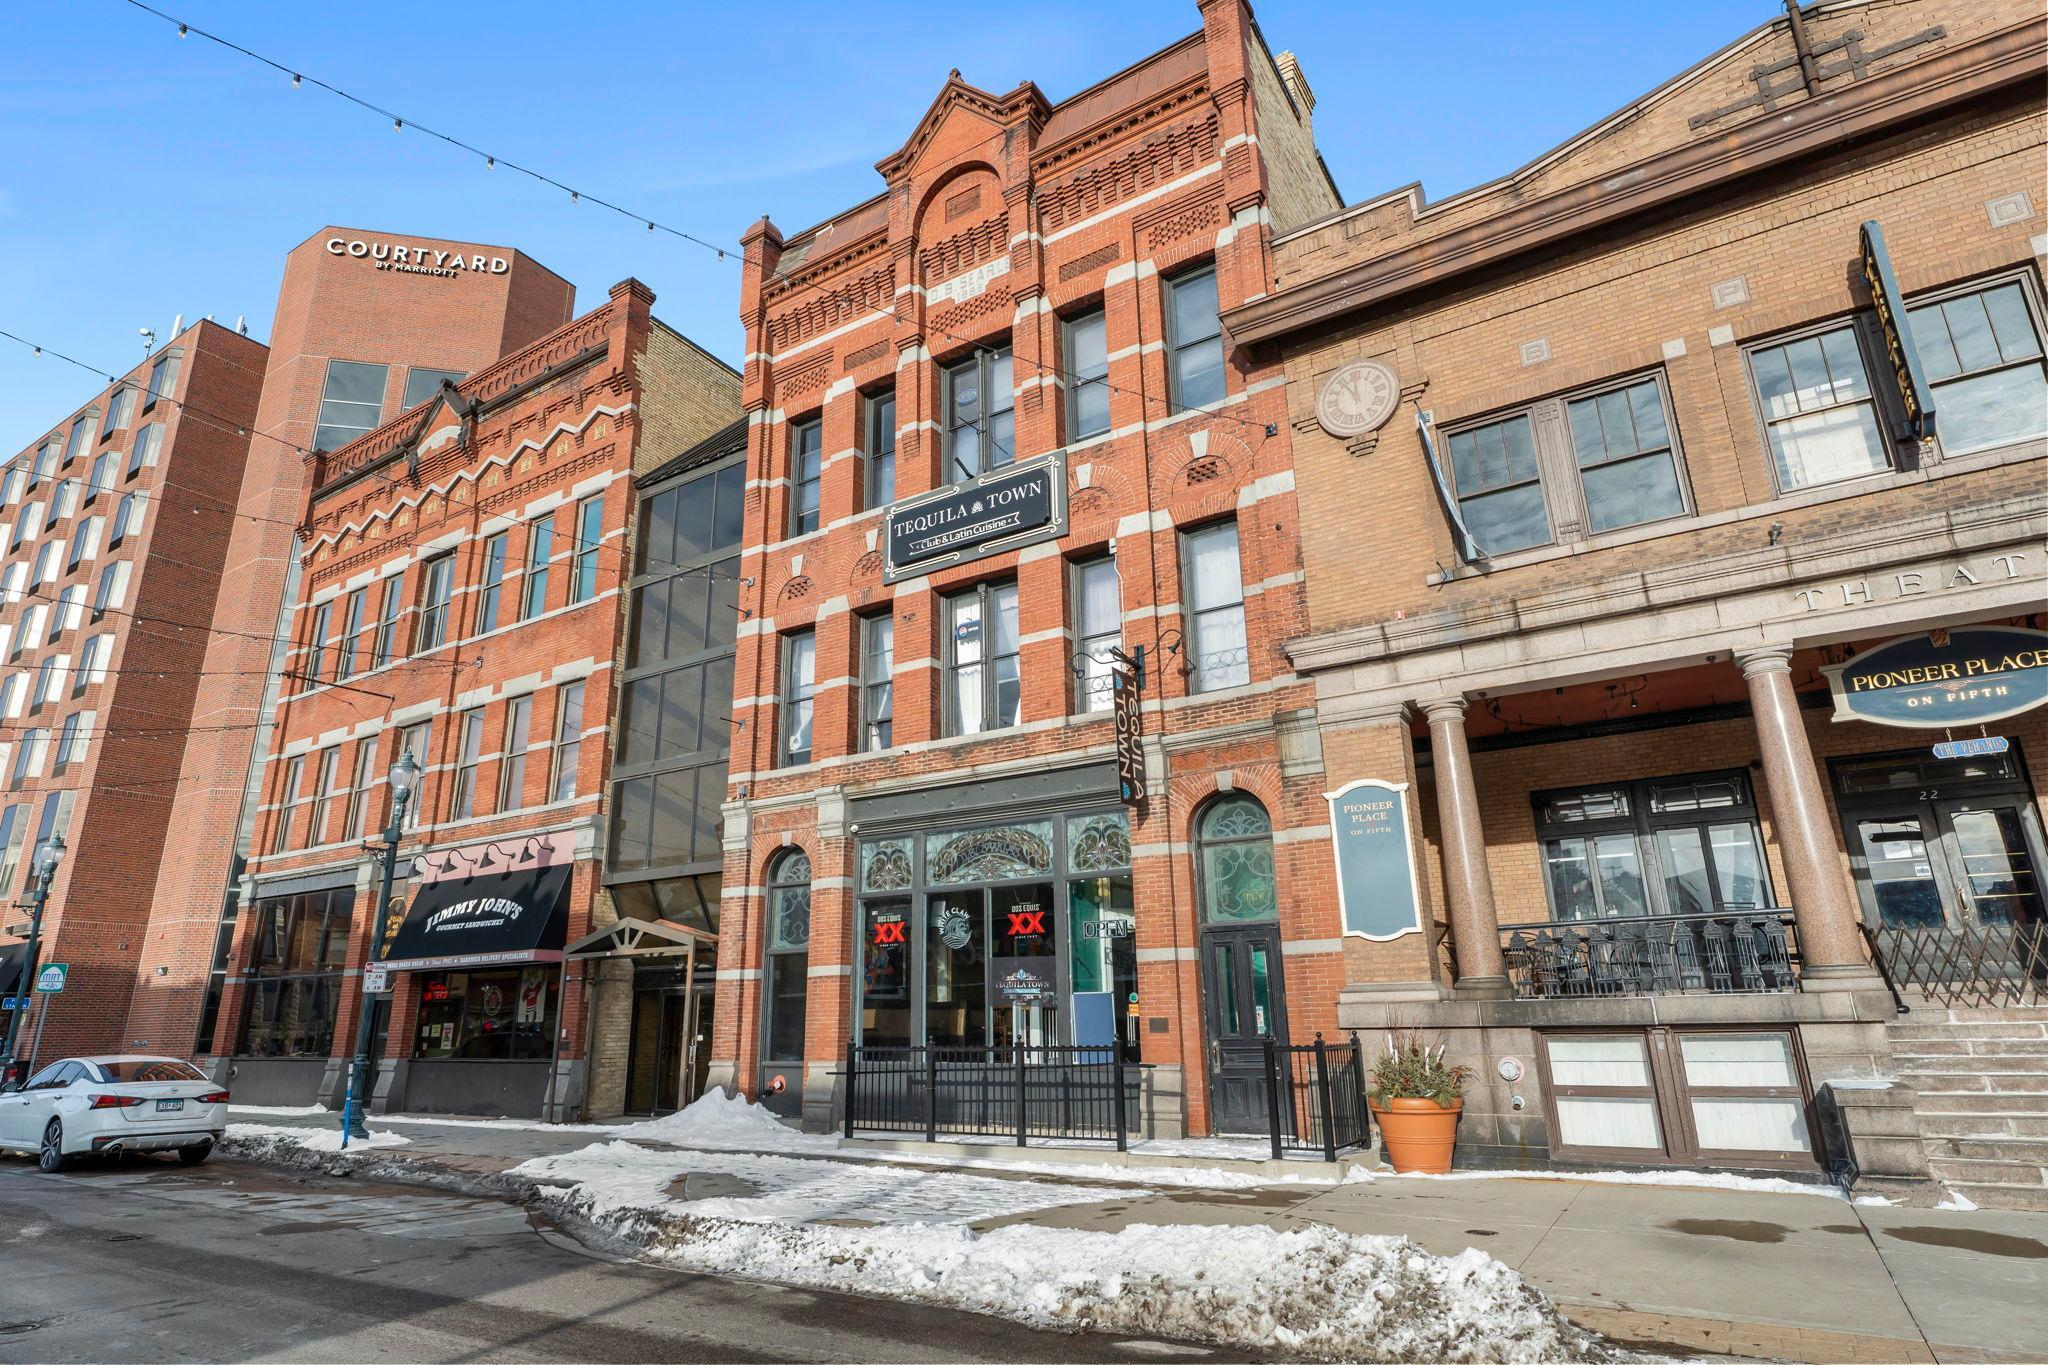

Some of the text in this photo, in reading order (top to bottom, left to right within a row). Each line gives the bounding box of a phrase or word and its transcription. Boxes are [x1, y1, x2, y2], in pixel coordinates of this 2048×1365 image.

[326, 238, 508, 273] COURTYARD
[376, 261, 456, 277] BY MARRIOTT
[894, 480, 1042, 538] TEQUILA TOWN
[921, 536, 942, 549] Club
[949, 528, 973, 542] Latin
[973, 519, 1007, 534] Cuisine
[1794, 554, 2025, 611] THEAT
[1852, 649, 2048, 692] PIONEER PLACE
[1907, 685, 2008, 708] ON FIFTH
[1116, 693, 1131, 778] TOWN
[1127, 681, 1144, 800] TEQUILA
[1919, 789, 1938, 801] 22
[1343, 801, 1394, 814] PIONEER
[1352, 811, 1388, 823] PLACE
[1366, 826, 1392, 834] FIFTH
[424, 899, 478, 933] JIMMY
[475, 898, 523, 920] JOHN'S
[877, 915, 887, 923] DOS
[1011, 903, 1040, 913] DOS EQUIS
[436, 918, 504, 932] GOURMET SANDWICHES
[873, 921, 907, 944] XX
[939, 907, 970, 935] WHITE CLAW
[1007, 911, 1046, 935] XX
[1085, 920, 1125, 937] OPEN
[502, 952, 528, 960] SPECIALISTS
[994, 980, 1050, 989] TEQUILA TOWN
